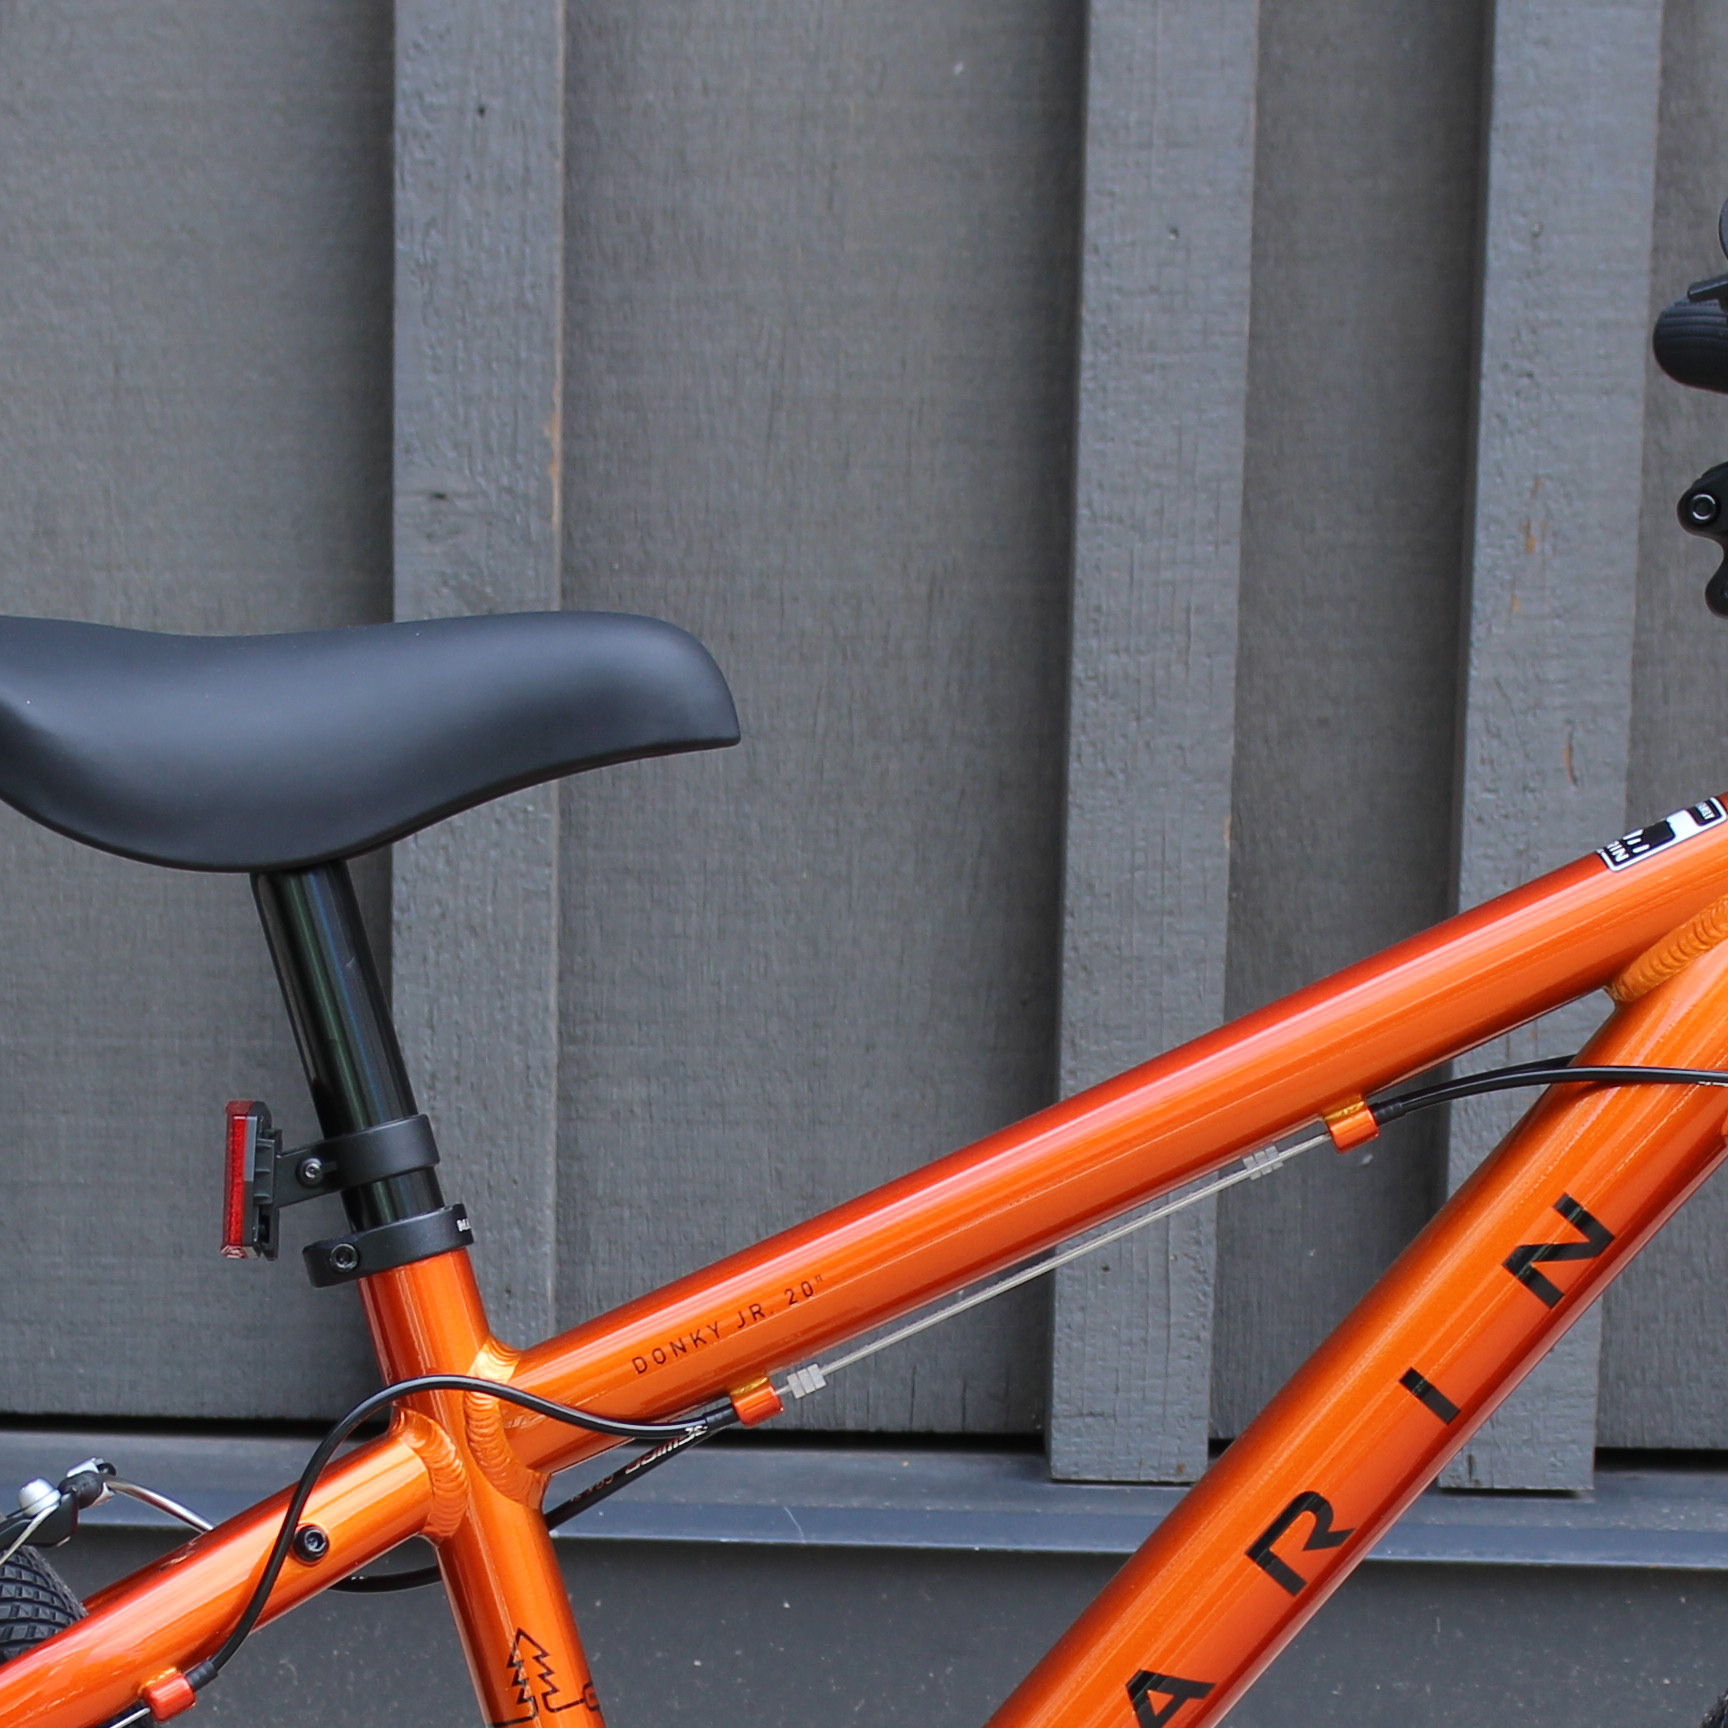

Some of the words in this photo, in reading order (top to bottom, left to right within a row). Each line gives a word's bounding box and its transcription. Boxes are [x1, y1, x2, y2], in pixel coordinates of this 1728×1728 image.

[632, 1321, 720, 1375] DONKY
[737, 1303, 773, 1329] JR.
[784, 1274, 822, 1306] 20"
